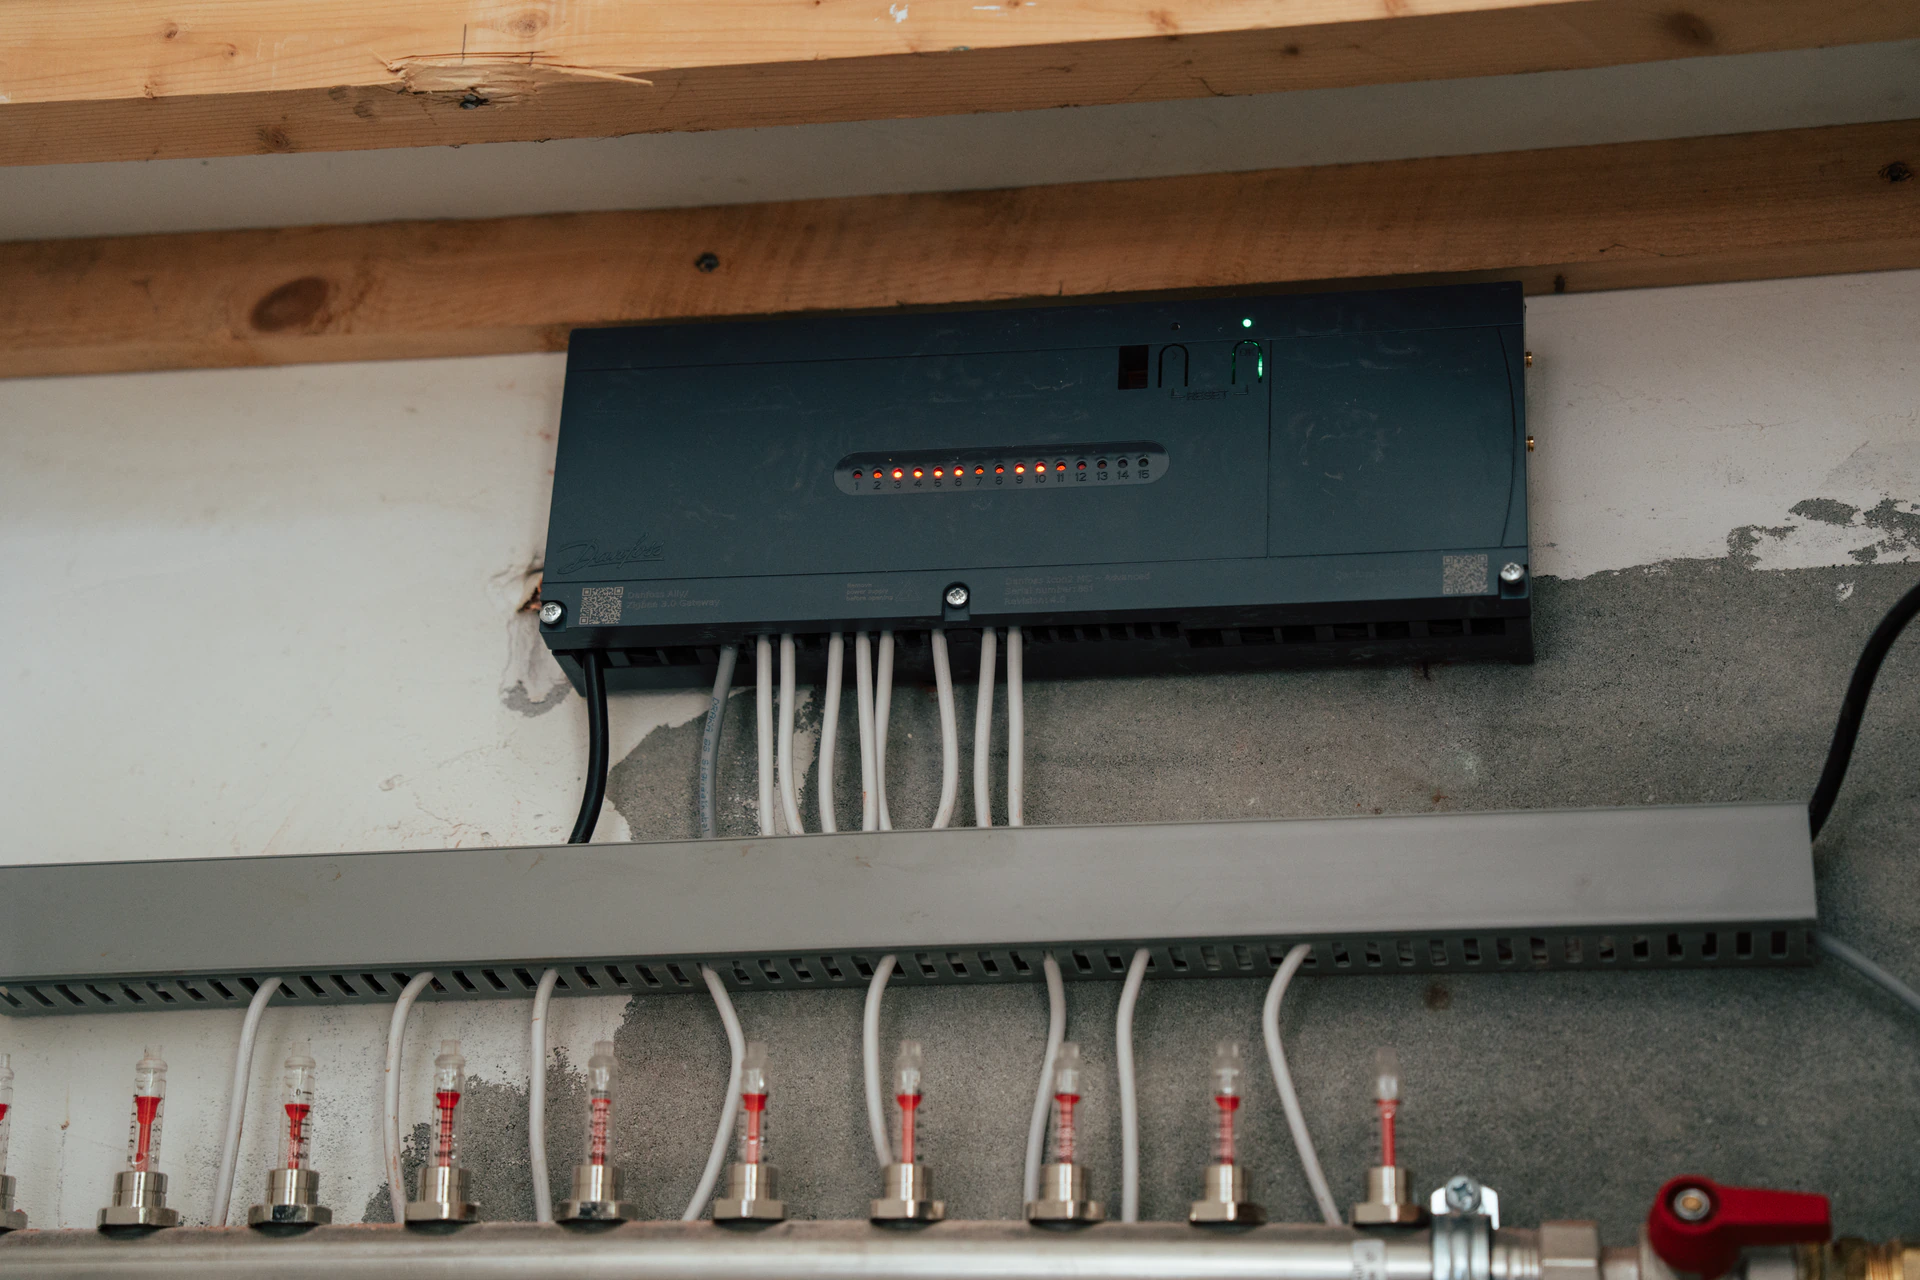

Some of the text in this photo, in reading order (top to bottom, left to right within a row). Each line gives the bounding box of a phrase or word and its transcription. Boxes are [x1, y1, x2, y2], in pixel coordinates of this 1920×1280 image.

[1186, 390, 1229, 401] RESET
[873, 481, 881, 490] 2
[894, 481, 902, 489] 3
[914, 480, 922, 488] 4
[934, 479, 942, 488] 5
[954, 478, 963, 487] 6
[975, 477, 983, 486] 7
[995, 476, 1003, 485] 8
[1016, 476, 1024, 484] 9
[1035, 475, 1046, 483] 10
[1057, 473, 1065, 482] 11
[1075, 473, 1087, 482] 12
[1097, 472, 1108, 481] 13
[1117, 471, 1129, 480] 14
[1138, 470, 1149, 479] 15
[557, 532, 665, 575] Danfoss
[1005, 576, 1043, 585] Danfoss
[1104, 572, 1150, 582] Advanced
[627, 590, 665, 599] Danfoss
[1004, 587, 1033, 595] Serial
[661, 600, 677, 608] 3.0
[679, 599, 720, 608] Gateway
[705, 697, 720, 732] DRAKA
